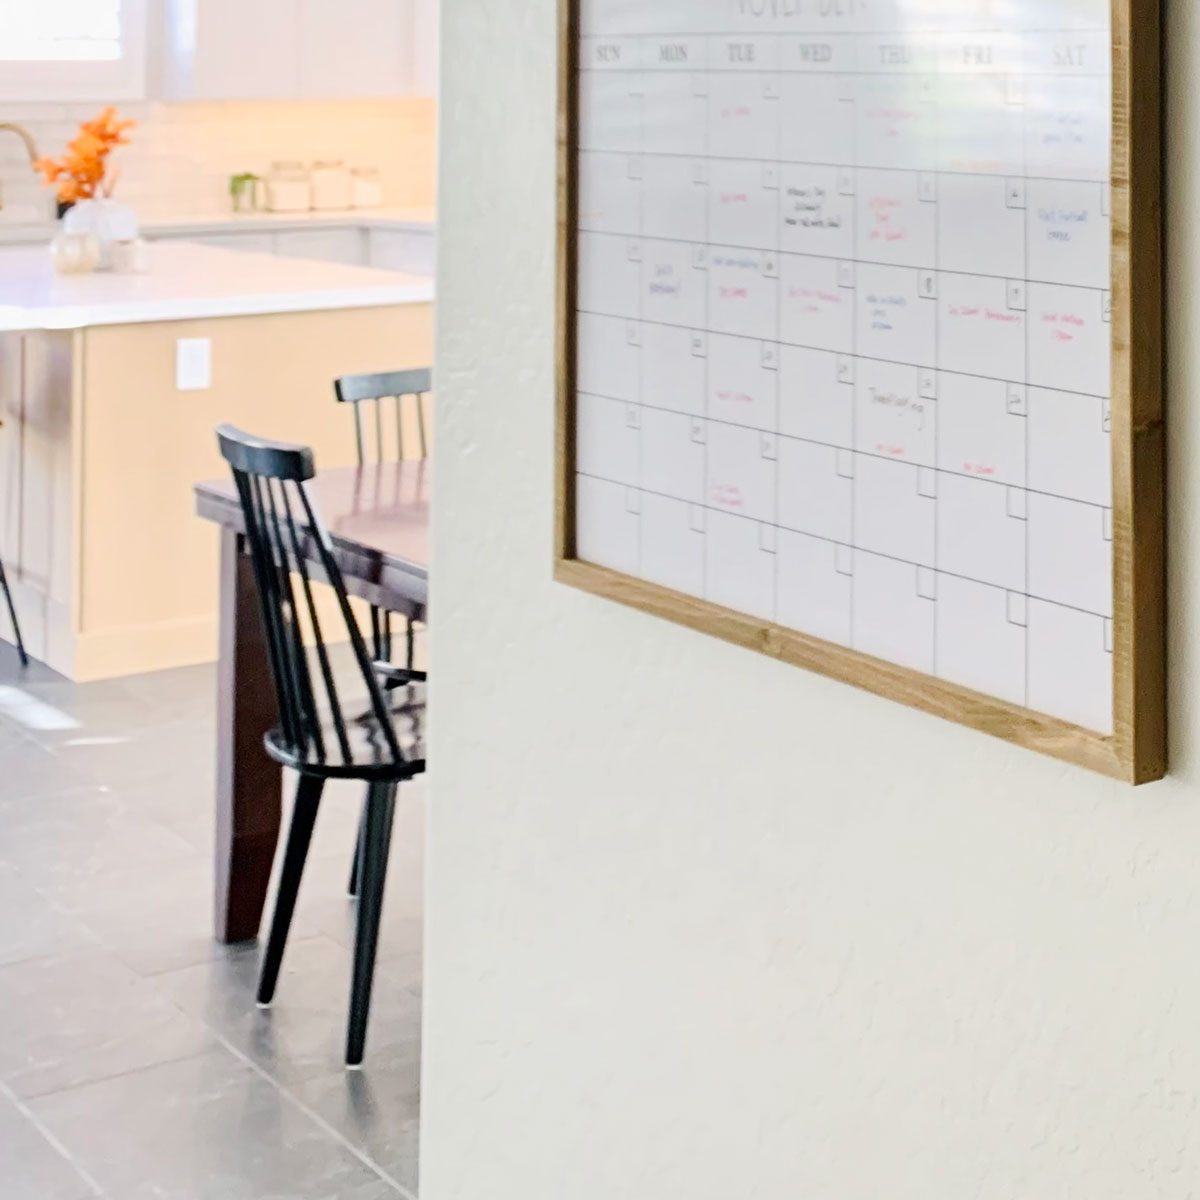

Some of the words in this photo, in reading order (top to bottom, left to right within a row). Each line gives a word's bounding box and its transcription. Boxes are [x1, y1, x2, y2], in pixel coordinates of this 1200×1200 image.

[659, 44, 688, 61] MON
[727, 44, 756, 62] TUE
[798, 43, 832, 62] WED
[880, 45, 911, 63] THU
[962, 44, 994, 64] FRI
[1052, 45, 1087, 65] SAT
